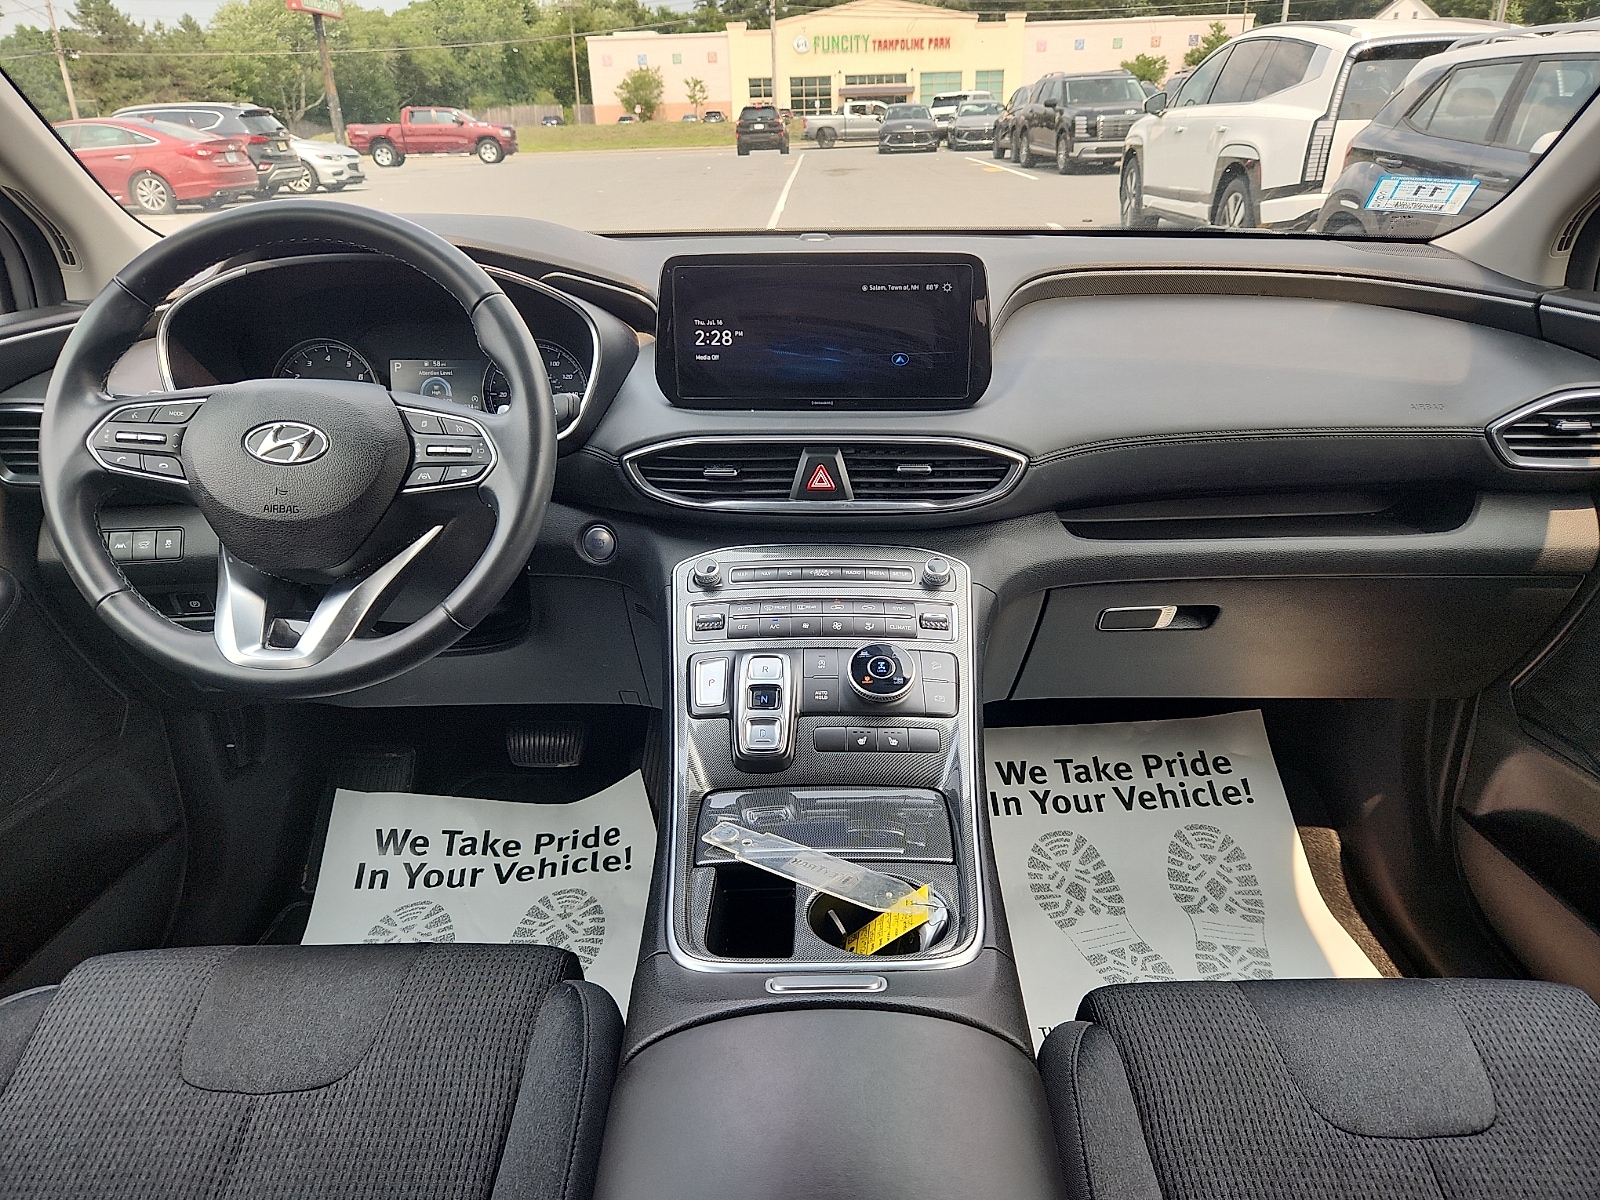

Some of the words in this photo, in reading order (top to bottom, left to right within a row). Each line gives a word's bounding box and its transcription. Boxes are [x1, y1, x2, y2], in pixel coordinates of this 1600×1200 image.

[813, 34, 870, 54] FUNCITY
[872, 38, 924, 52] TRAMPOLINE
[928, 37, 951, 50] PARK
[694, 330, 733, 346] 2:28
[394, 362, 402, 373] P
[1410, 403, 1445, 411] AIRBAG
[263, 504, 300, 514] AIRBAG
[760, 695, 768, 703] N
[760, 729, 766, 737] D
[994, 760, 1048, 786] We
[1054, 756, 1134, 784] Take
[1142, 750, 1233, 779] Pride
[990, 791, 1023, 817] In
[1028, 789, 1106, 815] Your
[1112, 778, 1255, 812] Vehicle!
[375, 828, 430, 857] We
[441, 829, 522, 858] Take
[534, 825, 621, 855] Pride
[354, 864, 389, 890] In
[402, 862, 484, 890] Your
[493, 846, 632, 885] Vehicle!
